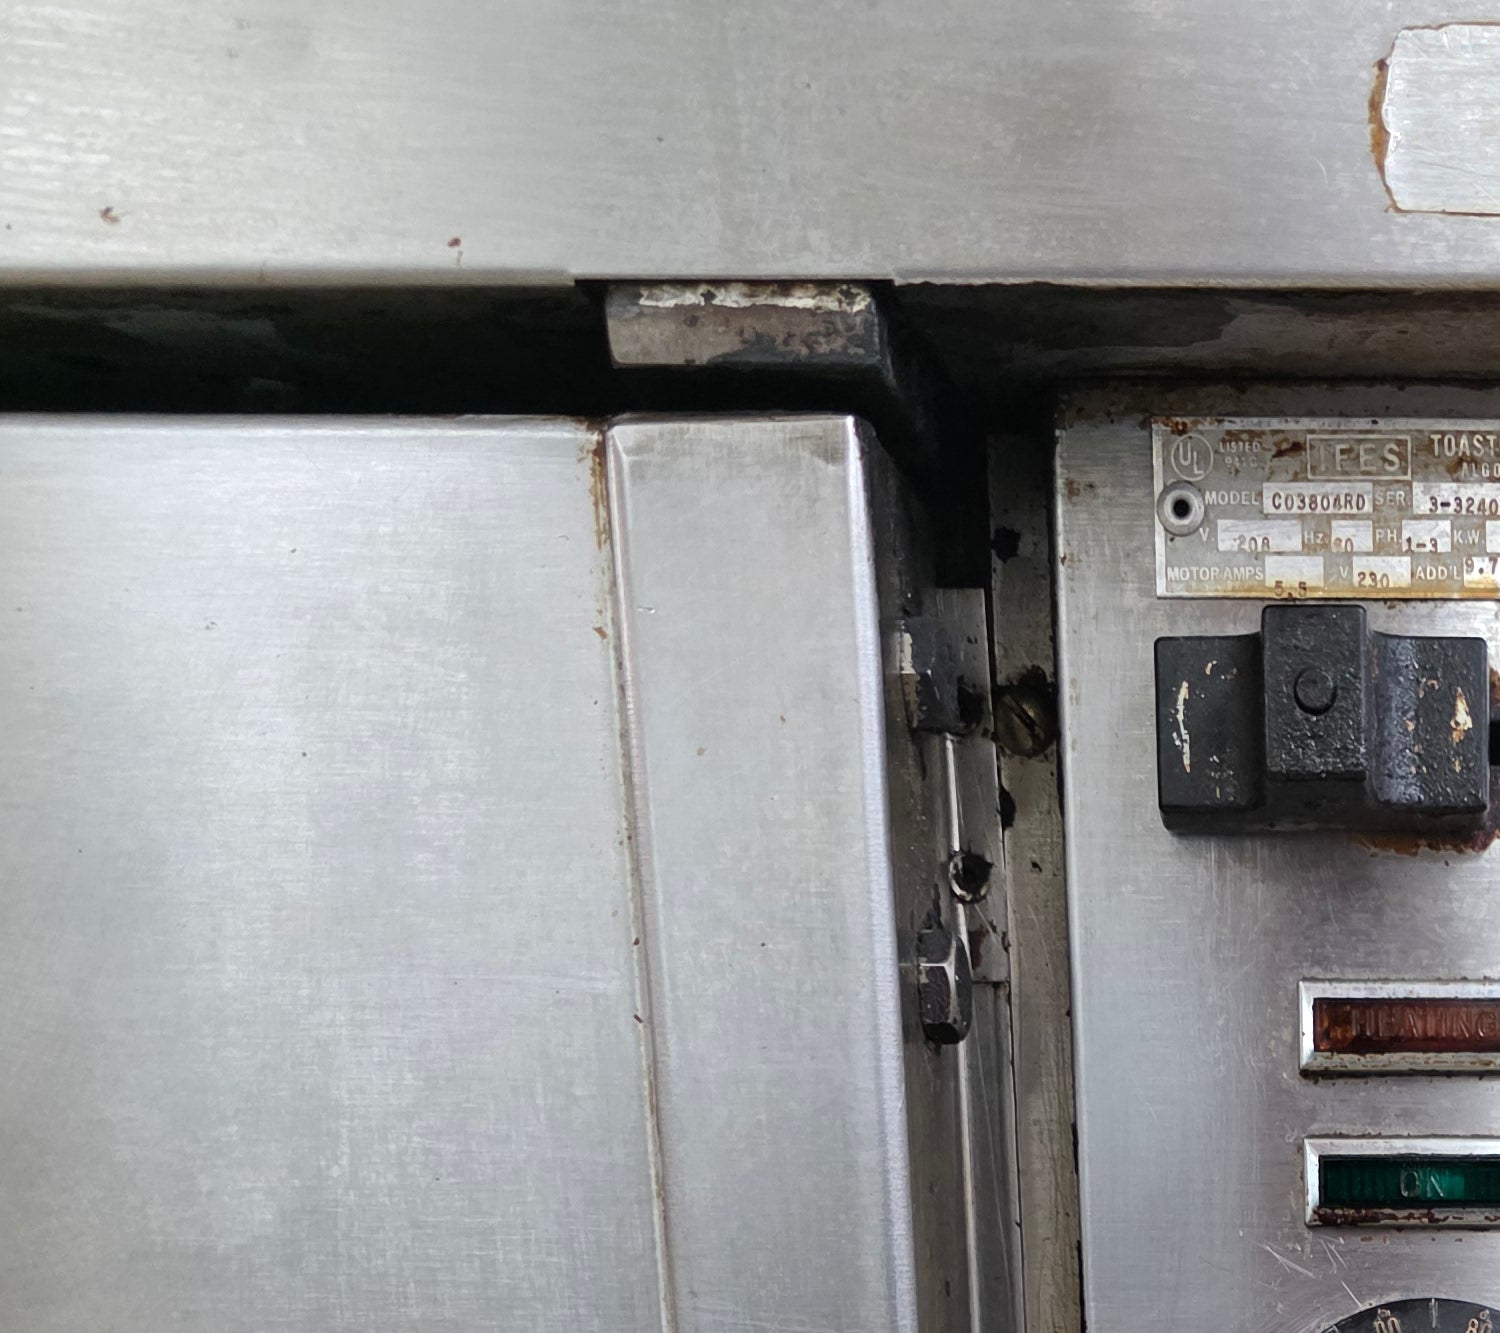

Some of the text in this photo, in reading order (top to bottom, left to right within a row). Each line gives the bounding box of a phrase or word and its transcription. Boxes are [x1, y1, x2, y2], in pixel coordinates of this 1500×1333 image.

[1219, 441, 1261, 454] LISTED
[1178, 439, 1204, 475] UL
[1205, 490, 1259, 506] MODEL
[1375, 490, 1412, 506] SER.
[1376, 528, 1402, 543] PH.
[1454, 530, 1485, 544] K.W.
[1167, 566, 1264, 581] MOTOR AMPS
[1415, 556, 1498, 580] ADD'L 9.7
[1357, 571, 1390, 588] 230
[1274, 580, 1307, 600] 5.5
[1400, 1168, 1447, 1199] ON
